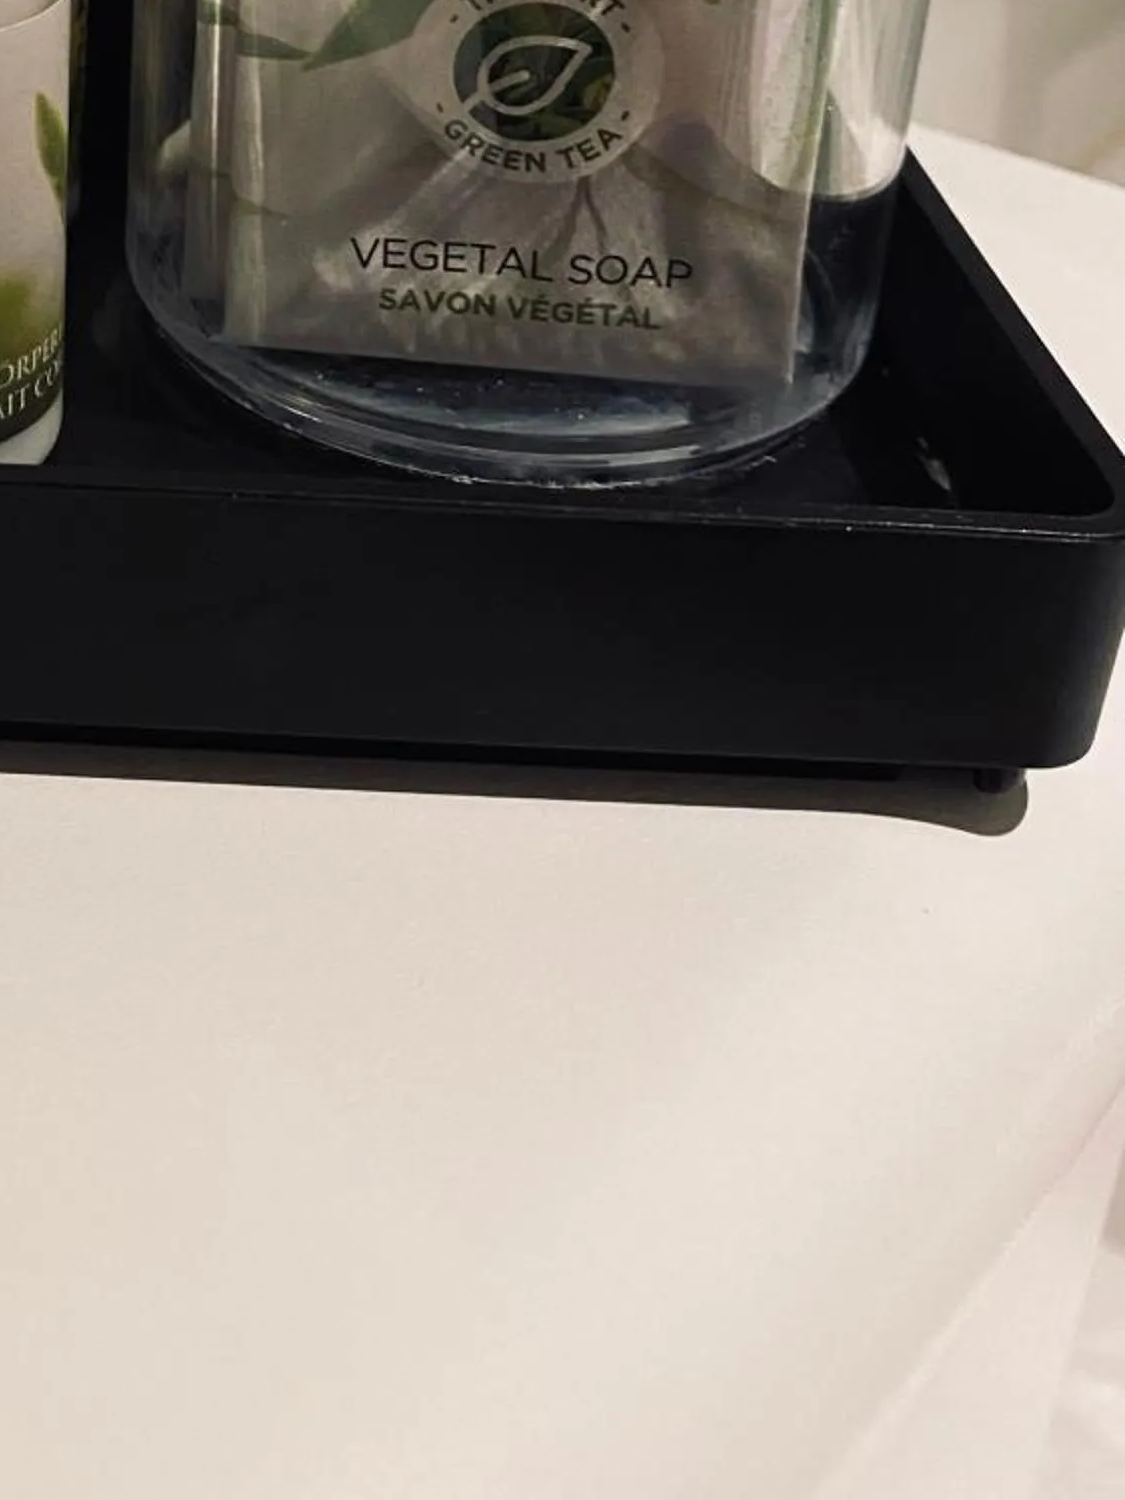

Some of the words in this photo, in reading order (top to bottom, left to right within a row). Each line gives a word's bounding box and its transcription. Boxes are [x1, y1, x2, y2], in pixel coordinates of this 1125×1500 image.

[443, 119, 546, 173] GREEN
[555, 128, 623, 169] TEA
[350, 237, 554, 282] VEGETAL
[567, 253, 694, 289] SOAP
[379, 288, 496, 316] SAVON
[507, 294, 662, 330] VÉGÉTAL
